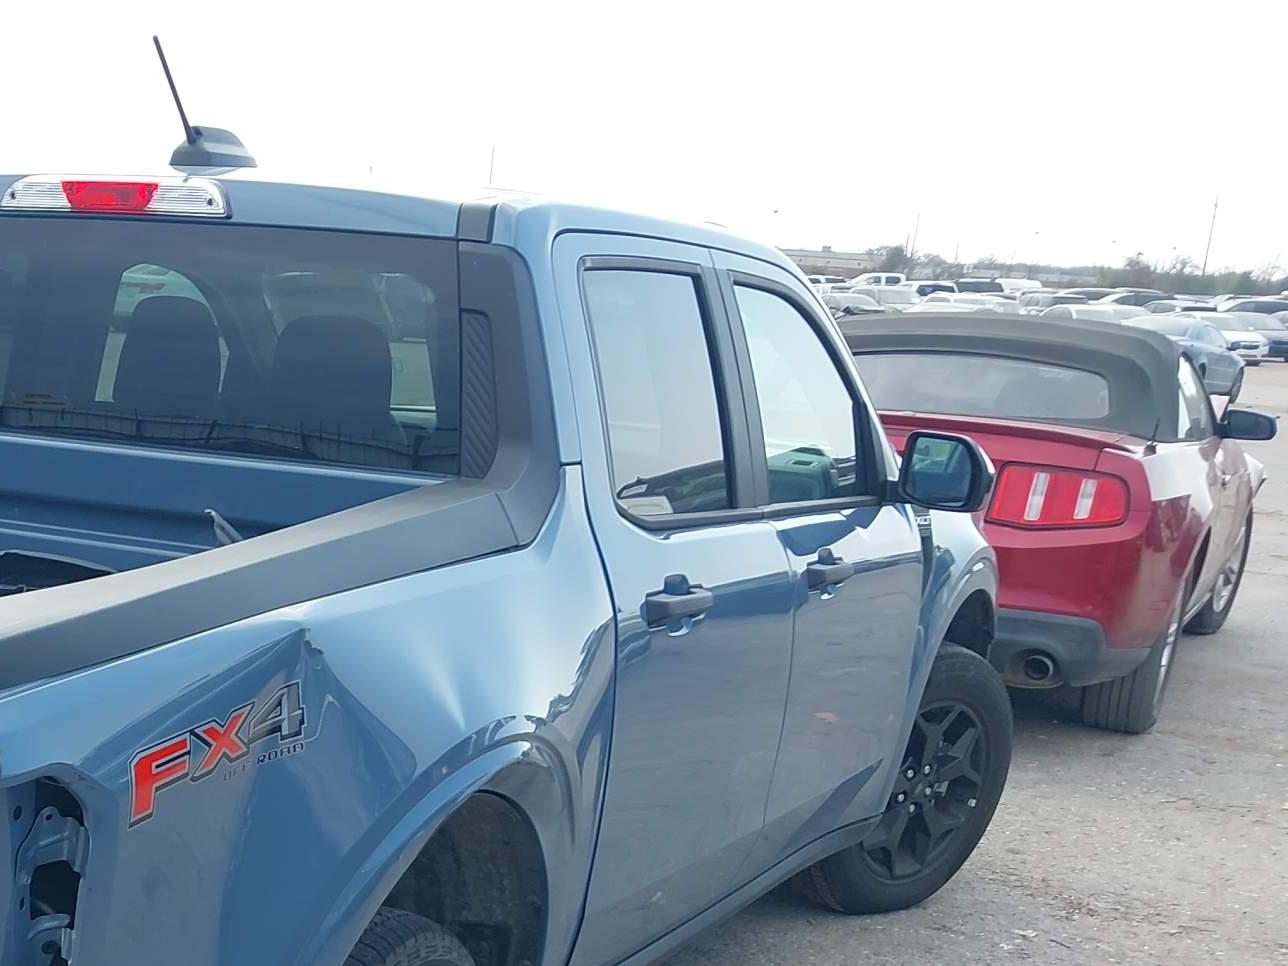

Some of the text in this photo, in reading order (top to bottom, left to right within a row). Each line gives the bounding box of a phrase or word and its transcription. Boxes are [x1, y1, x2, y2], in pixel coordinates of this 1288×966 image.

[128, 680, 306, 830] FX4
[223, 742, 304, 781] OFF ROAD
